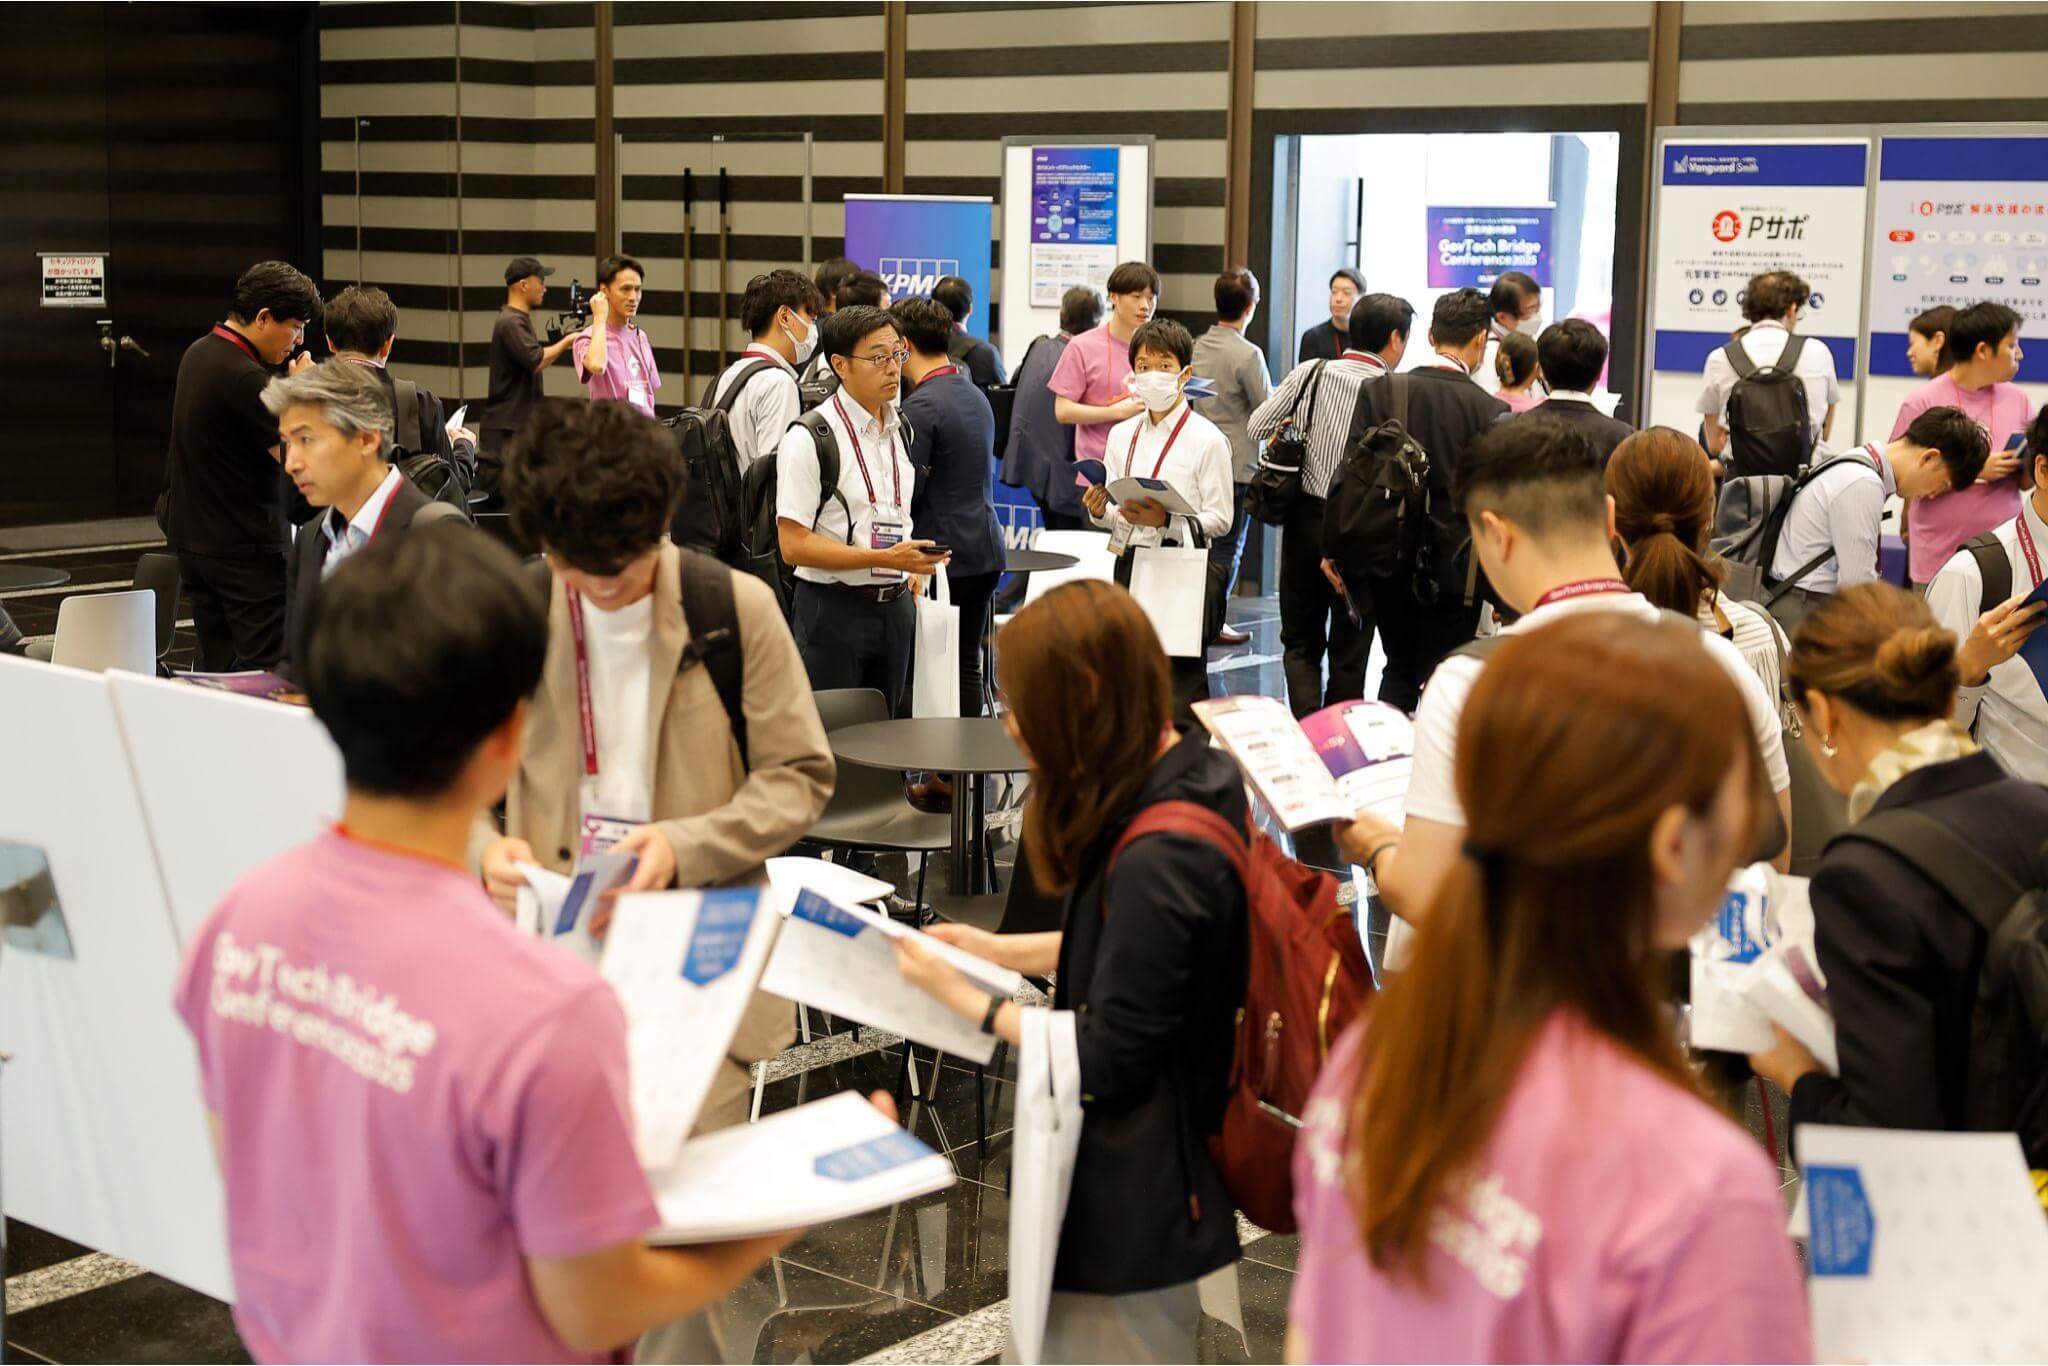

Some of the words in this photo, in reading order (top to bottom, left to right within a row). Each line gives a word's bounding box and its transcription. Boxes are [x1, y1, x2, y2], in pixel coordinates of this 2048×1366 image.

[1688, 162, 1736, 175] Vanguard
[1747, 214, 1810, 240] Pサポ
[1438, 238, 1496, 253] GovTech
[1497, 238, 1541, 255] Bridge
[880, 273, 949, 295] KPM
